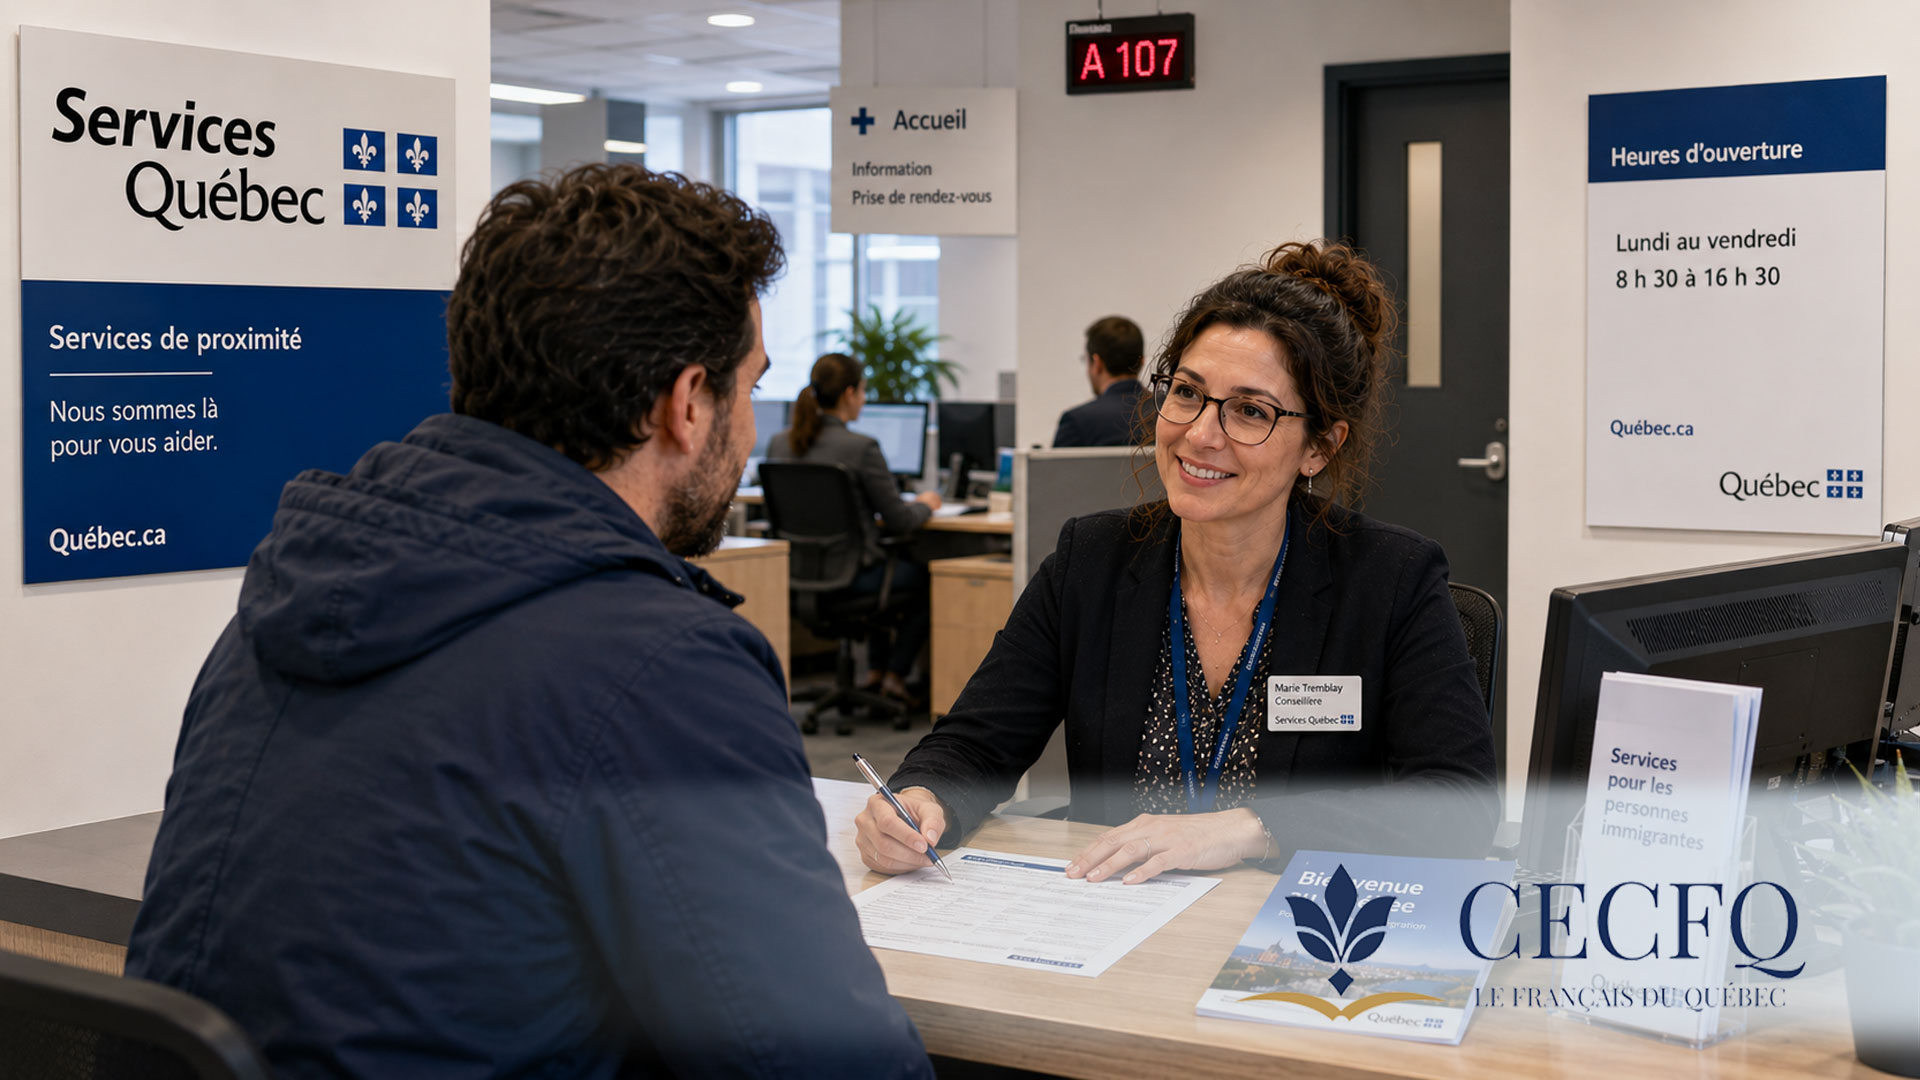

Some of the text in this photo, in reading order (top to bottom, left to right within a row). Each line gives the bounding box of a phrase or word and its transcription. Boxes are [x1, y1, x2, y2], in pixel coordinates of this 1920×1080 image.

[1080, 38, 1178, 80] A 107
[51, 86, 277, 158] Services
[892, 108, 967, 131] Accueil
[1611, 145, 1680, 168] Heures
[852, 162, 933, 178] Information
[125, 160, 326, 232] Québec
[852, 188, 993, 206] Prise de rendez-vous
[1616, 228, 1798, 253] Lundi au vendredi
[1615, 266, 1781, 289] 8 h 30 à 16 h 30
[49, 324, 303, 356] Services de proximité
[50, 397, 219, 423] Nous sommes là
[1609, 419, 1695, 439] Québec.ca
[50, 429, 219, 463] pour vous aider.
[1719, 470, 1821, 501] Québec
[49, 524, 167, 557] Québec.ca
[1275, 683, 1343, 694] Marie Tremblay
[1275, 715, 1307, 725] Services
[1610, 747, 1678, 773] Services
[1608, 772, 1674, 797] pour les
[1604, 797, 1689, 824] personnes
[1600, 820, 1705, 852] immigrantes
[1298, 871, 1424, 896] Bievenue
[1367, 1011, 1421, 1028] Québec
